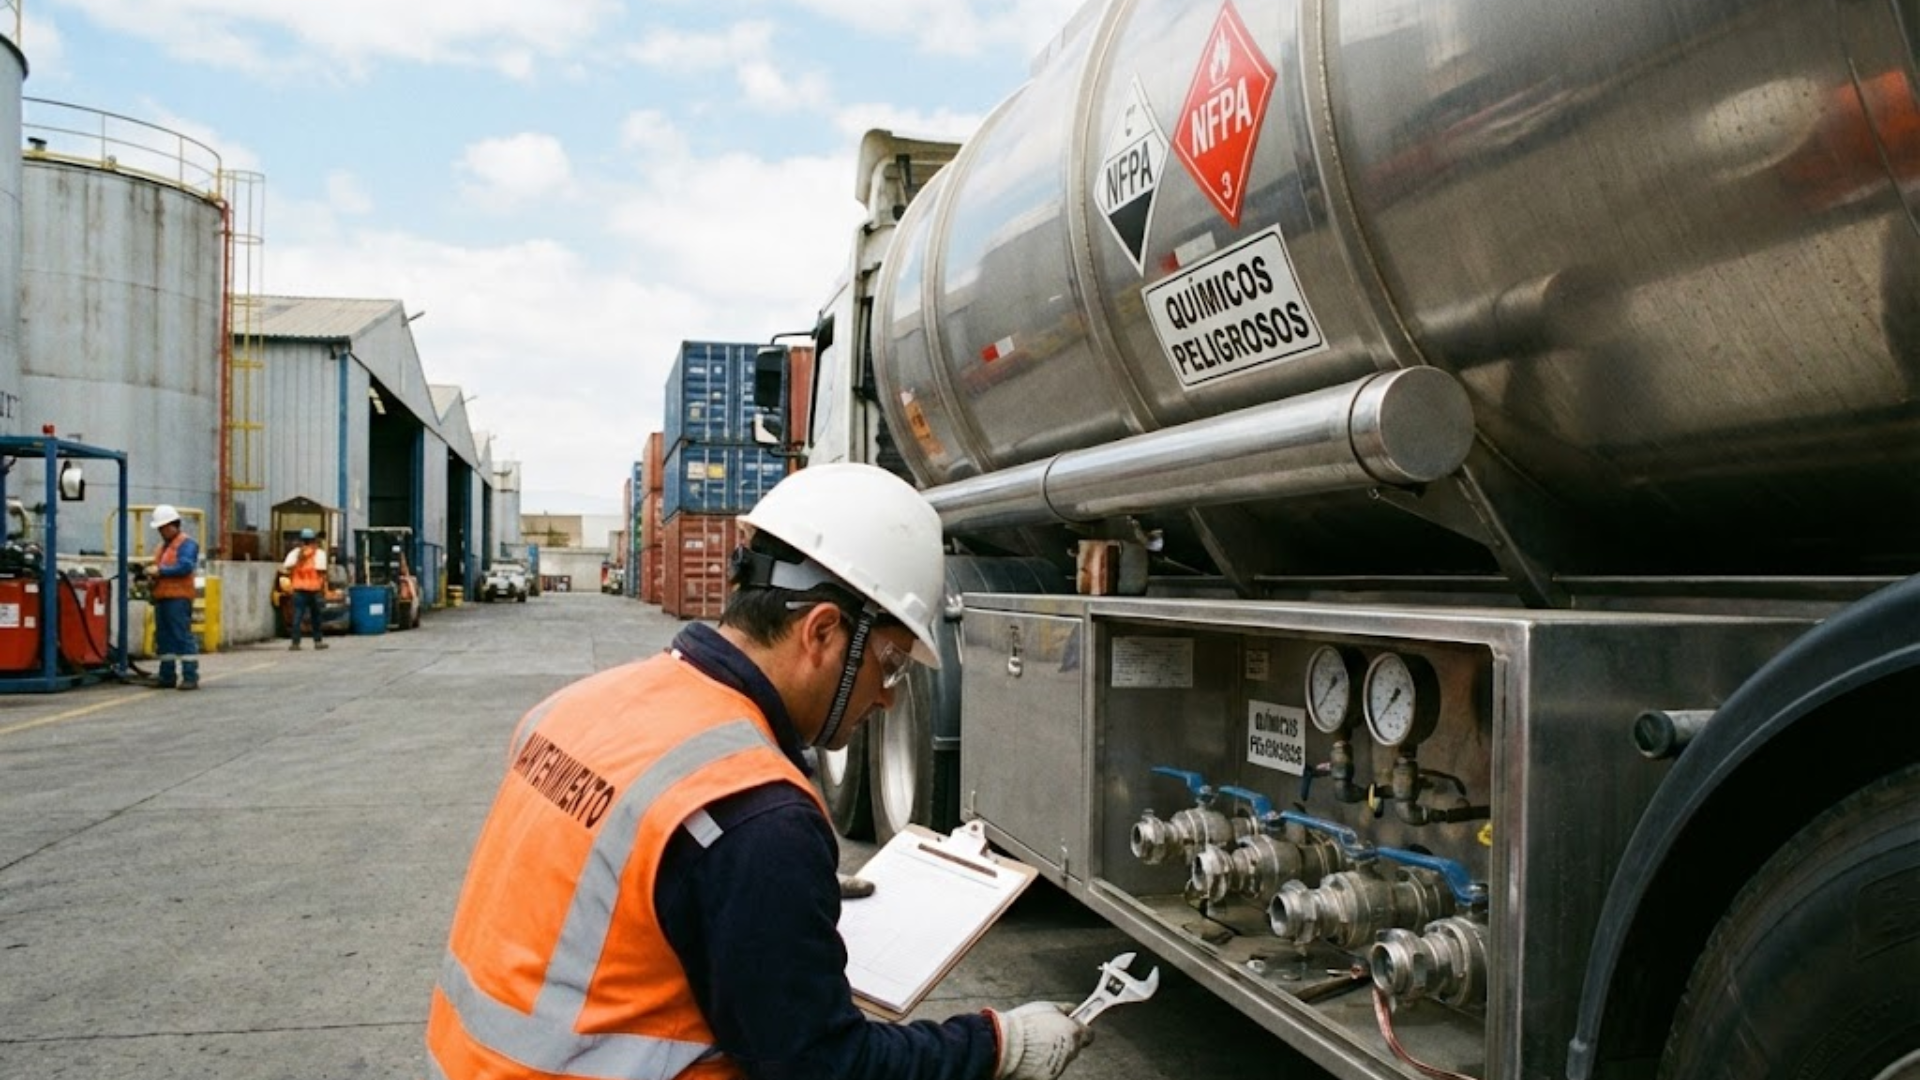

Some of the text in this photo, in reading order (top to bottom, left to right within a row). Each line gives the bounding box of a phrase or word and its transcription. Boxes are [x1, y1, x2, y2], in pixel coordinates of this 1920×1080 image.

[1190, 76, 1253, 158] NFPA
[1106, 140, 1154, 210] NFPA
[1220, 170, 1233, 200] 3
[1165, 255, 1274, 331] QUÍMICOS
[1171, 301, 1310, 376] PELIGROSOS
